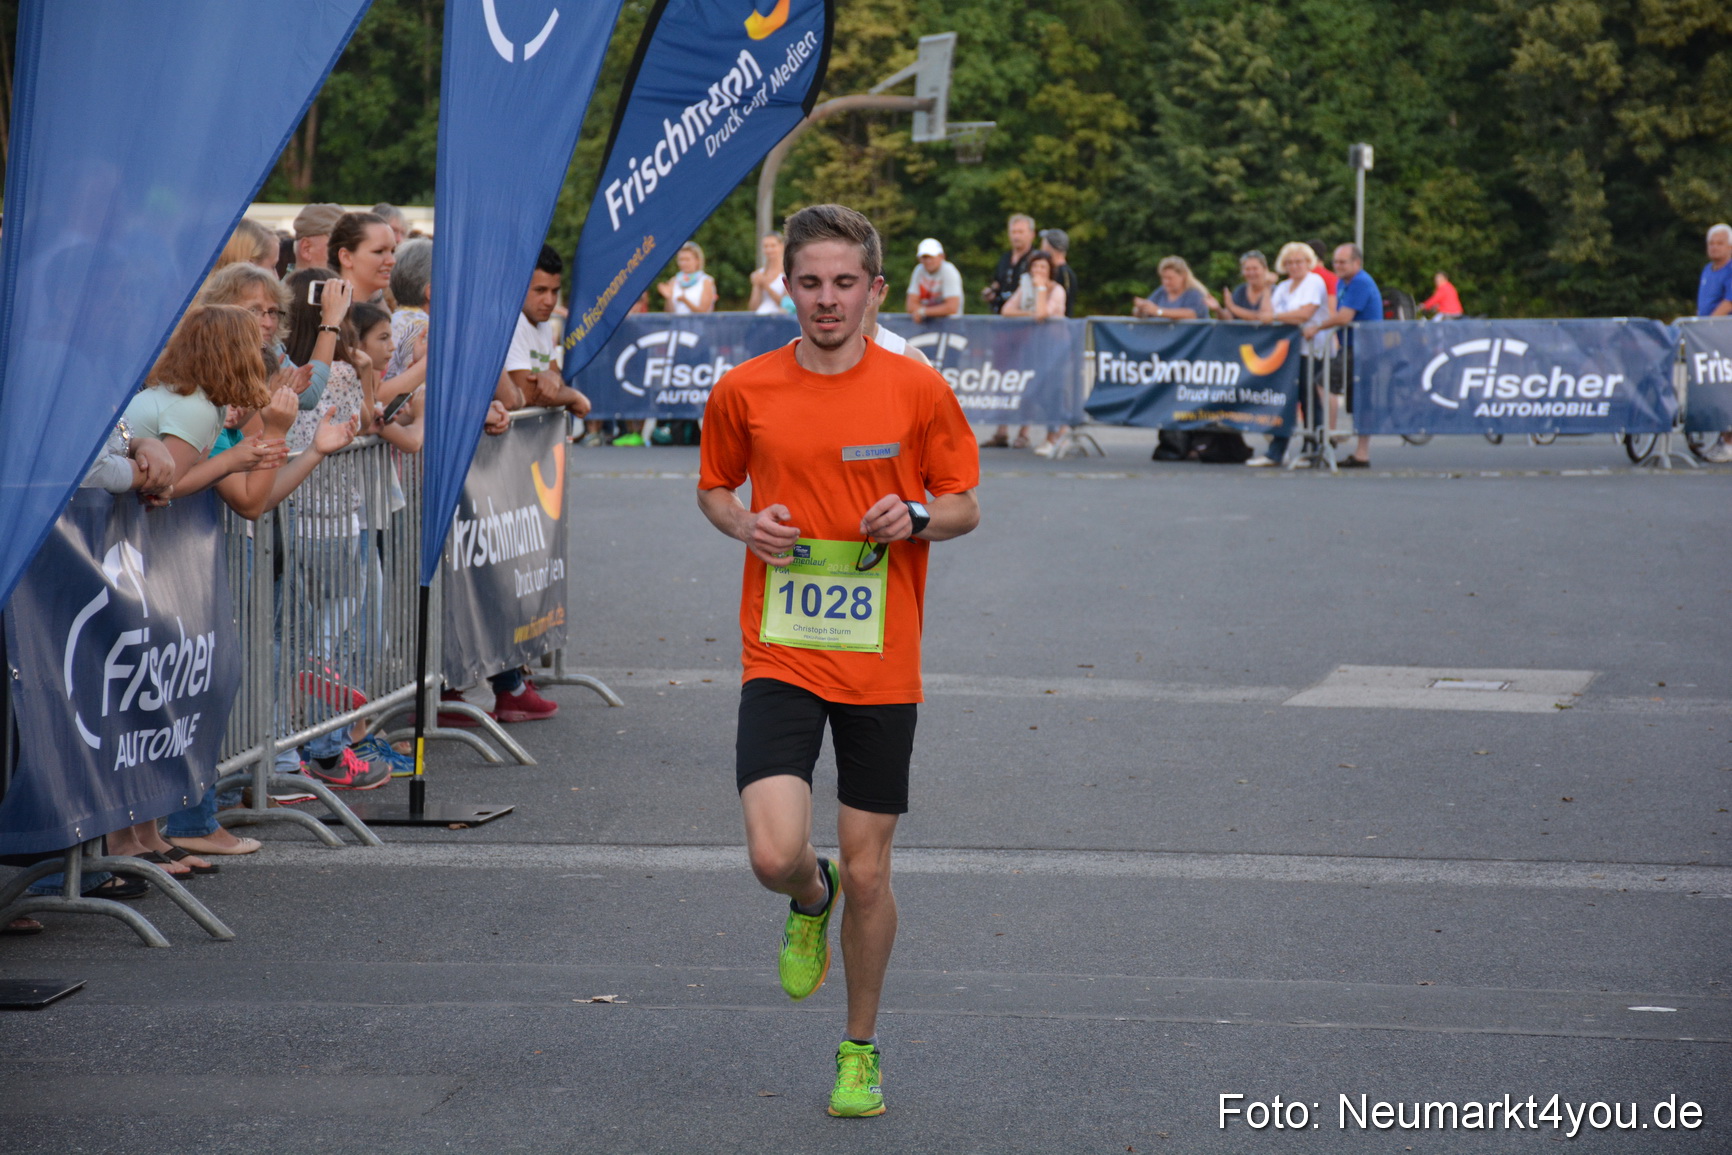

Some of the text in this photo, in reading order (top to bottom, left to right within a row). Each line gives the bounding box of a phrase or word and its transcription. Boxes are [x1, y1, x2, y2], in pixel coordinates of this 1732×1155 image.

[705, 108, 744, 158] Druck
[769, 31, 818, 94] Medien
[604, 49, 763, 231] Frischmann
[643, 356, 735, 388] Fisch
[936, 360, 1036, 393] scher
[1098, 351, 1241, 386] Frischmann
[1459, 366, 1624, 400] Fischer
[1694, 350, 1732, 385] Fris
[958, 394, 1022, 410] OMOBILE
[1210, 386, 1237, 403] und
[1239, 388, 1287, 407] Medien
[1474, 401, 1611, 418] AUTOMOBILE
[865, 448, 891, 456] STURM
[779, 580, 873, 621] 1028
[793, 624, 828, 634] Christoph
[101, 615, 215, 717] Fischer
